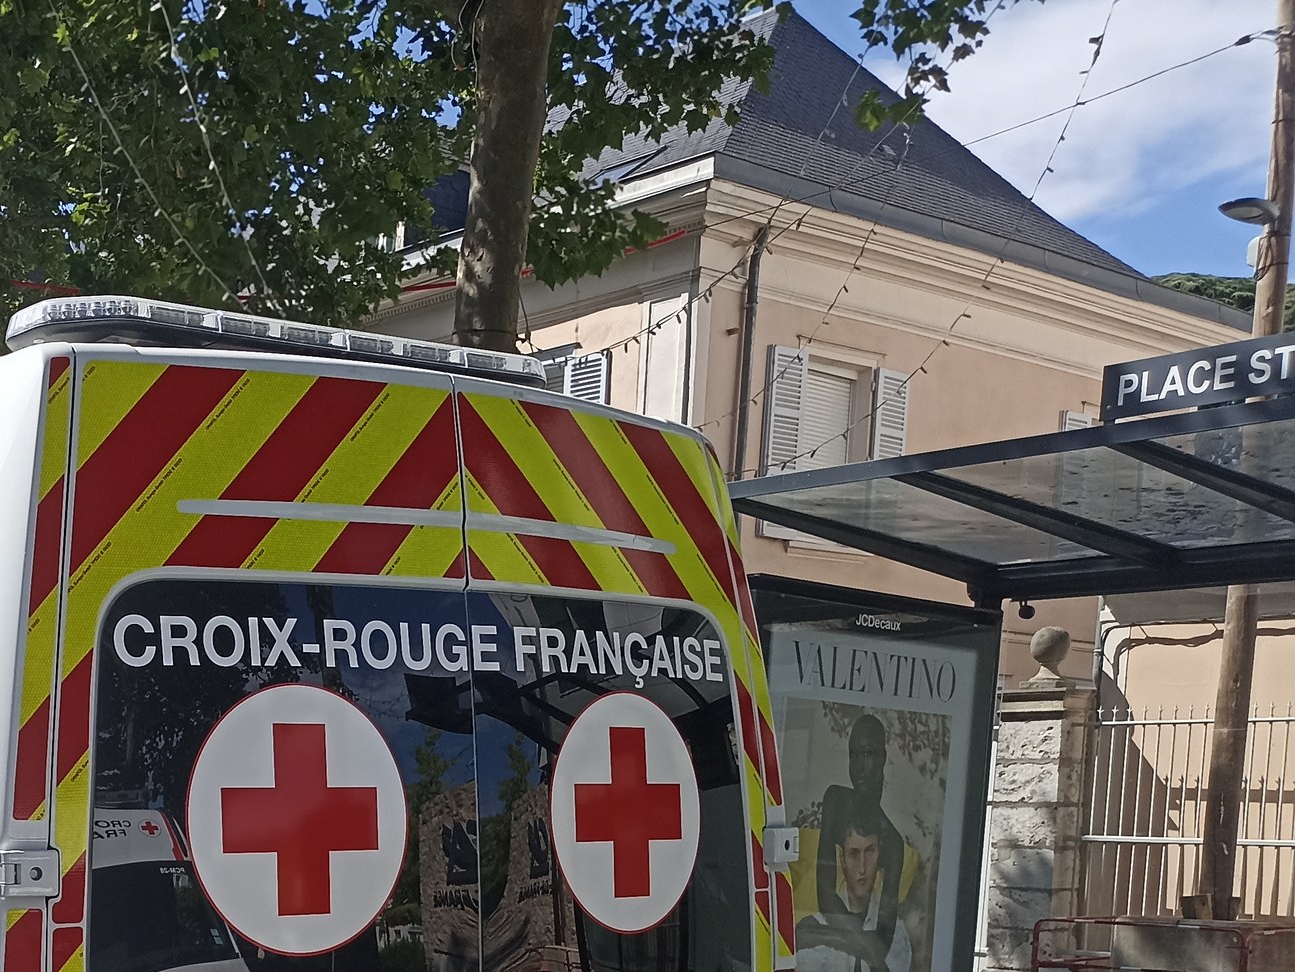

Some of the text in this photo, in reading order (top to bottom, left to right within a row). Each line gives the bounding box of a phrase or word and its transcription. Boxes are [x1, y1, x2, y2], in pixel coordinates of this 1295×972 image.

[1117, 355, 1237, 406] PLACE
[855, 613, 901, 631] JCDecaux
[113, 613, 723, 689] CROIX-ROUGE FRANÇAISE
[793, 640, 956, 703] VALENTINO
